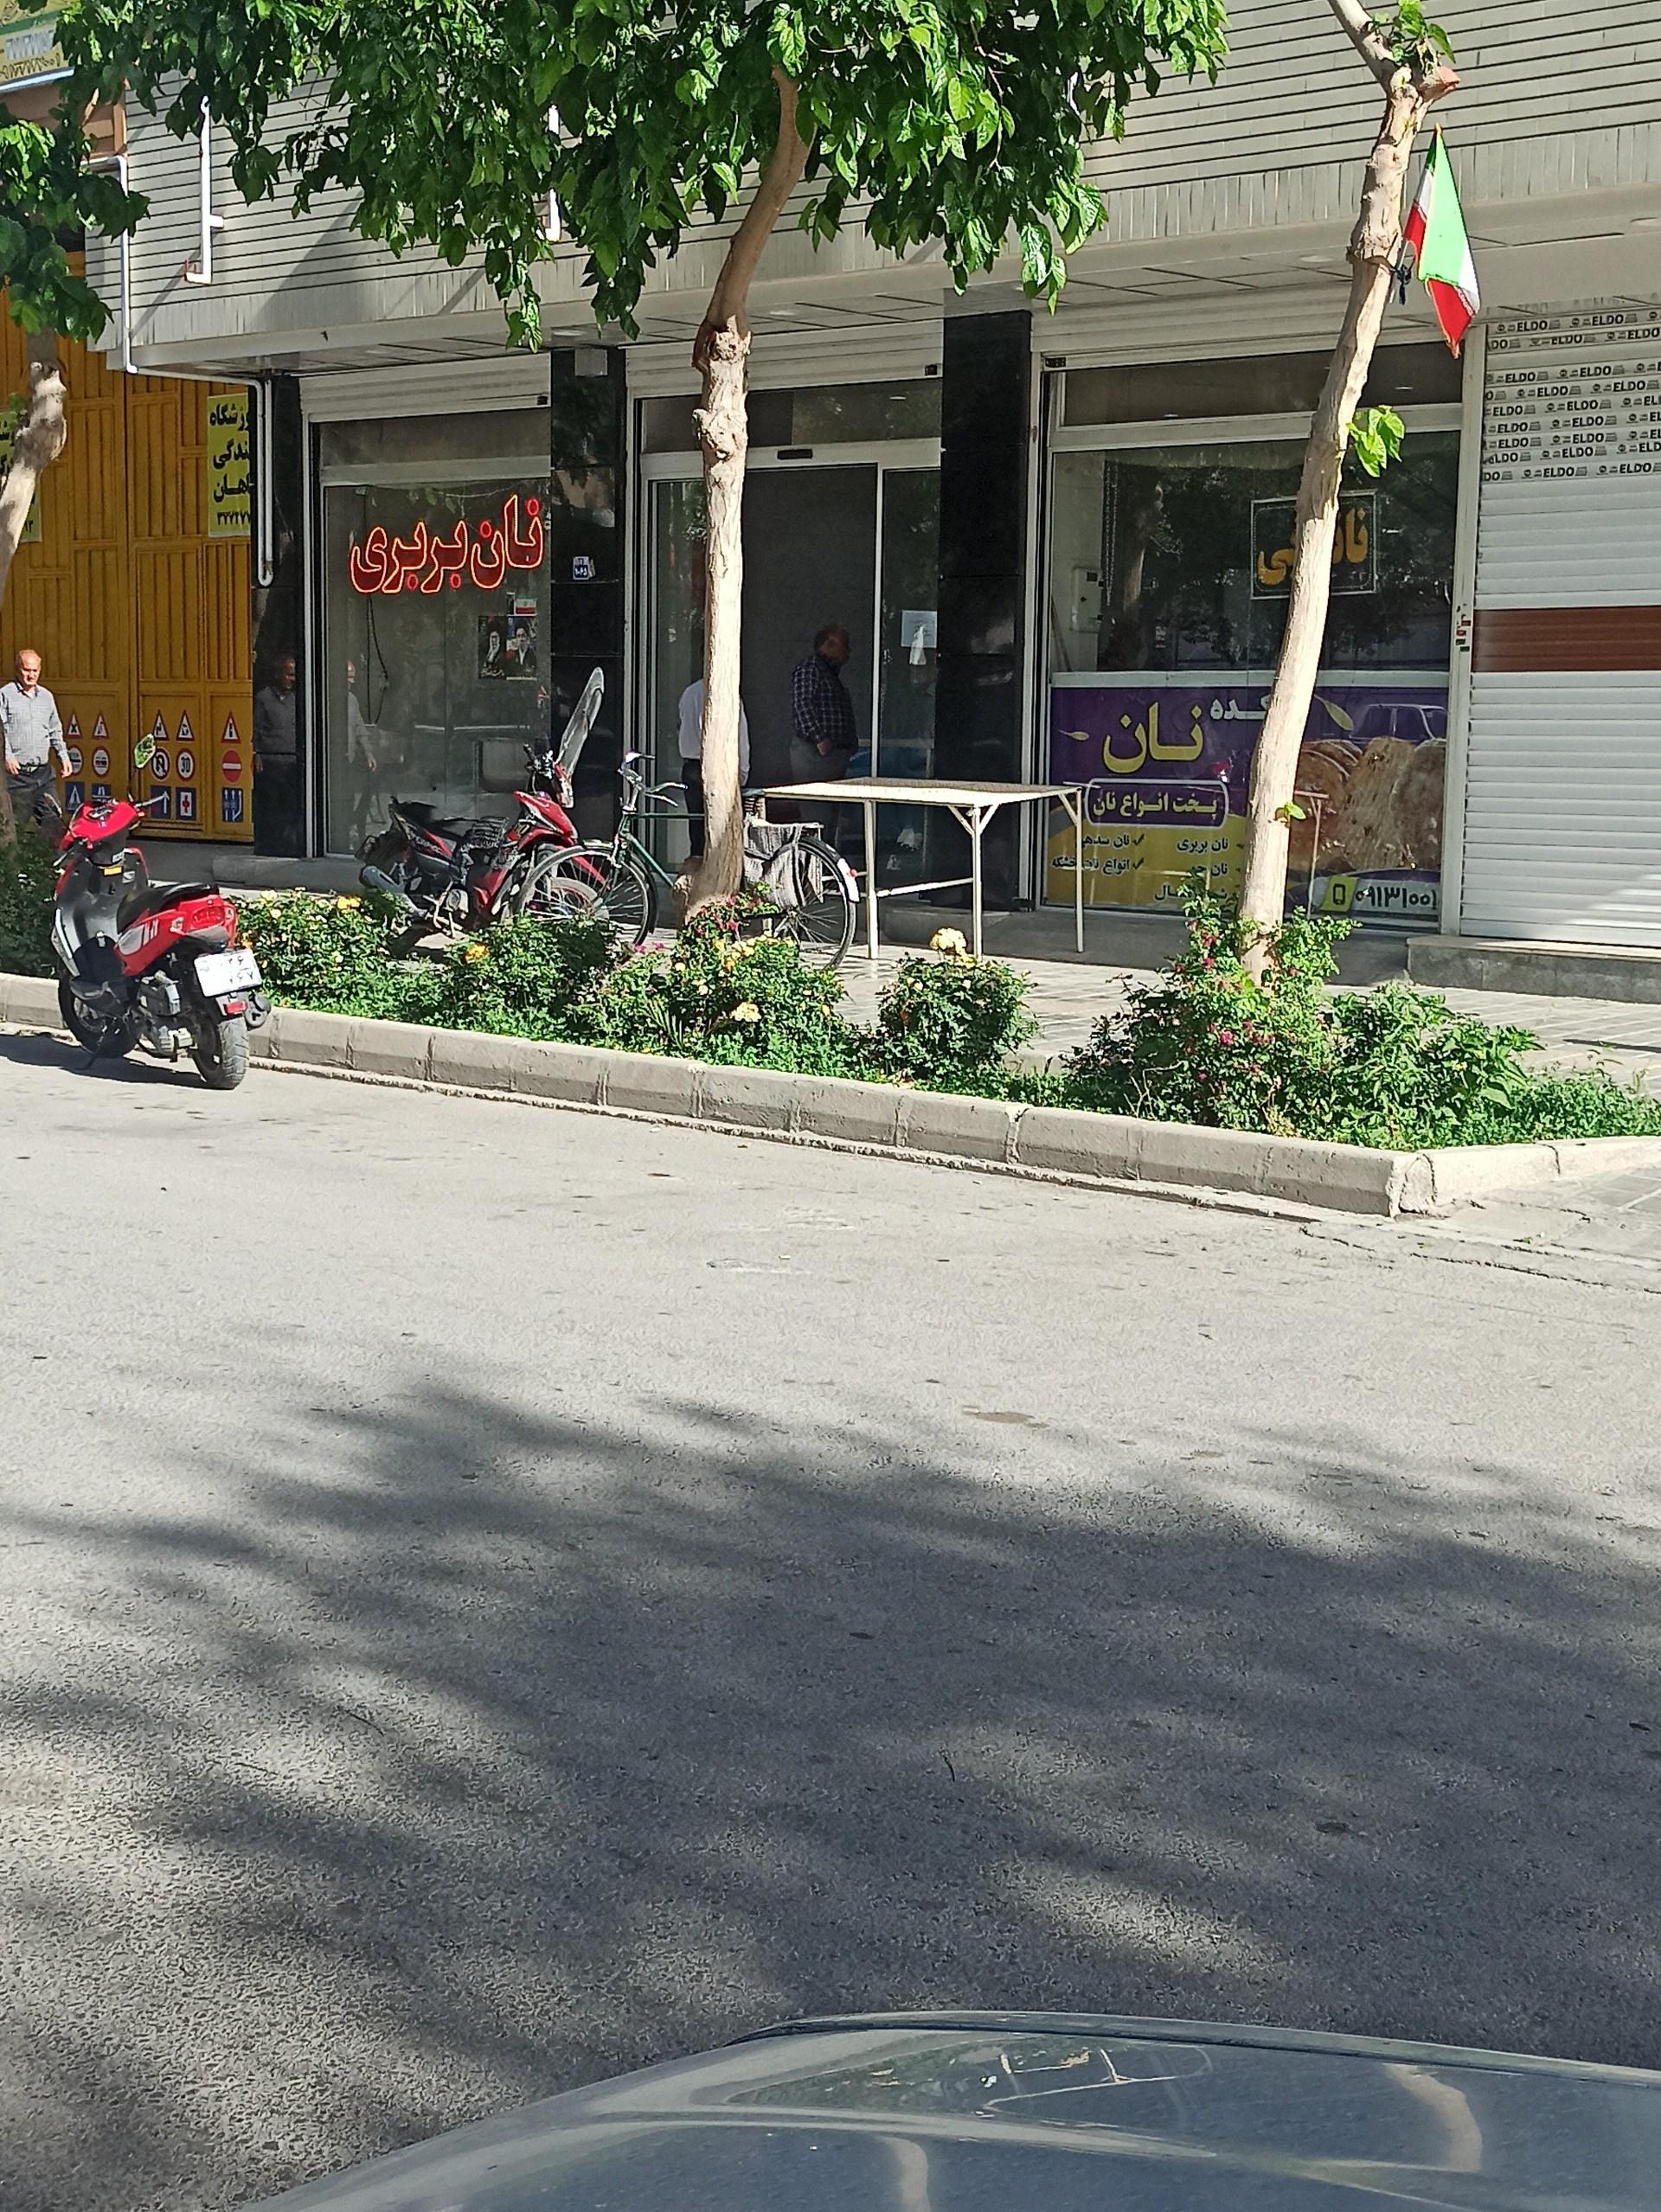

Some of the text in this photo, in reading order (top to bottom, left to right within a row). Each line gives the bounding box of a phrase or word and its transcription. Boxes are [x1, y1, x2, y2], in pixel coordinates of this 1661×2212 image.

[1517, 314, 1624, 332] ELDO ELDO
[1627, 327, 1660, 339] ELDO
[1505, 372, 1536, 383] ELDO
[1580, 366, 1611, 377] ELDO
[1537, 386, 1568, 397] ELDO
[1613, 381, 1645, 392] ELDO
[1493, 406, 1523, 416] ELDO
[1567, 400, 1598, 411] ELDO
[1497, 422, 1528, 433] ELDO
[1572, 416, 1604, 427] ELDO
[1498, 438, 1529, 449] ELDO
[1573, 433, 1604, 444] ELDO
[1562, 446, 1594, 458] ELDO
[1543, 466, 1574, 478] ELDO
[1619, 462, 1652, 474] ELDO
[350, 494, 543, 593] نان بربری
[1102, 702, 1204, 774] نان
[1093, 792, 1217, 819] پخت انواع نان
[1113, 834, 1129, 848] نان
[1177, 837, 1228, 854] نان بربری
[1102, 859, 1130, 875] انواع
[1210, 862, 1228, 876] نان
